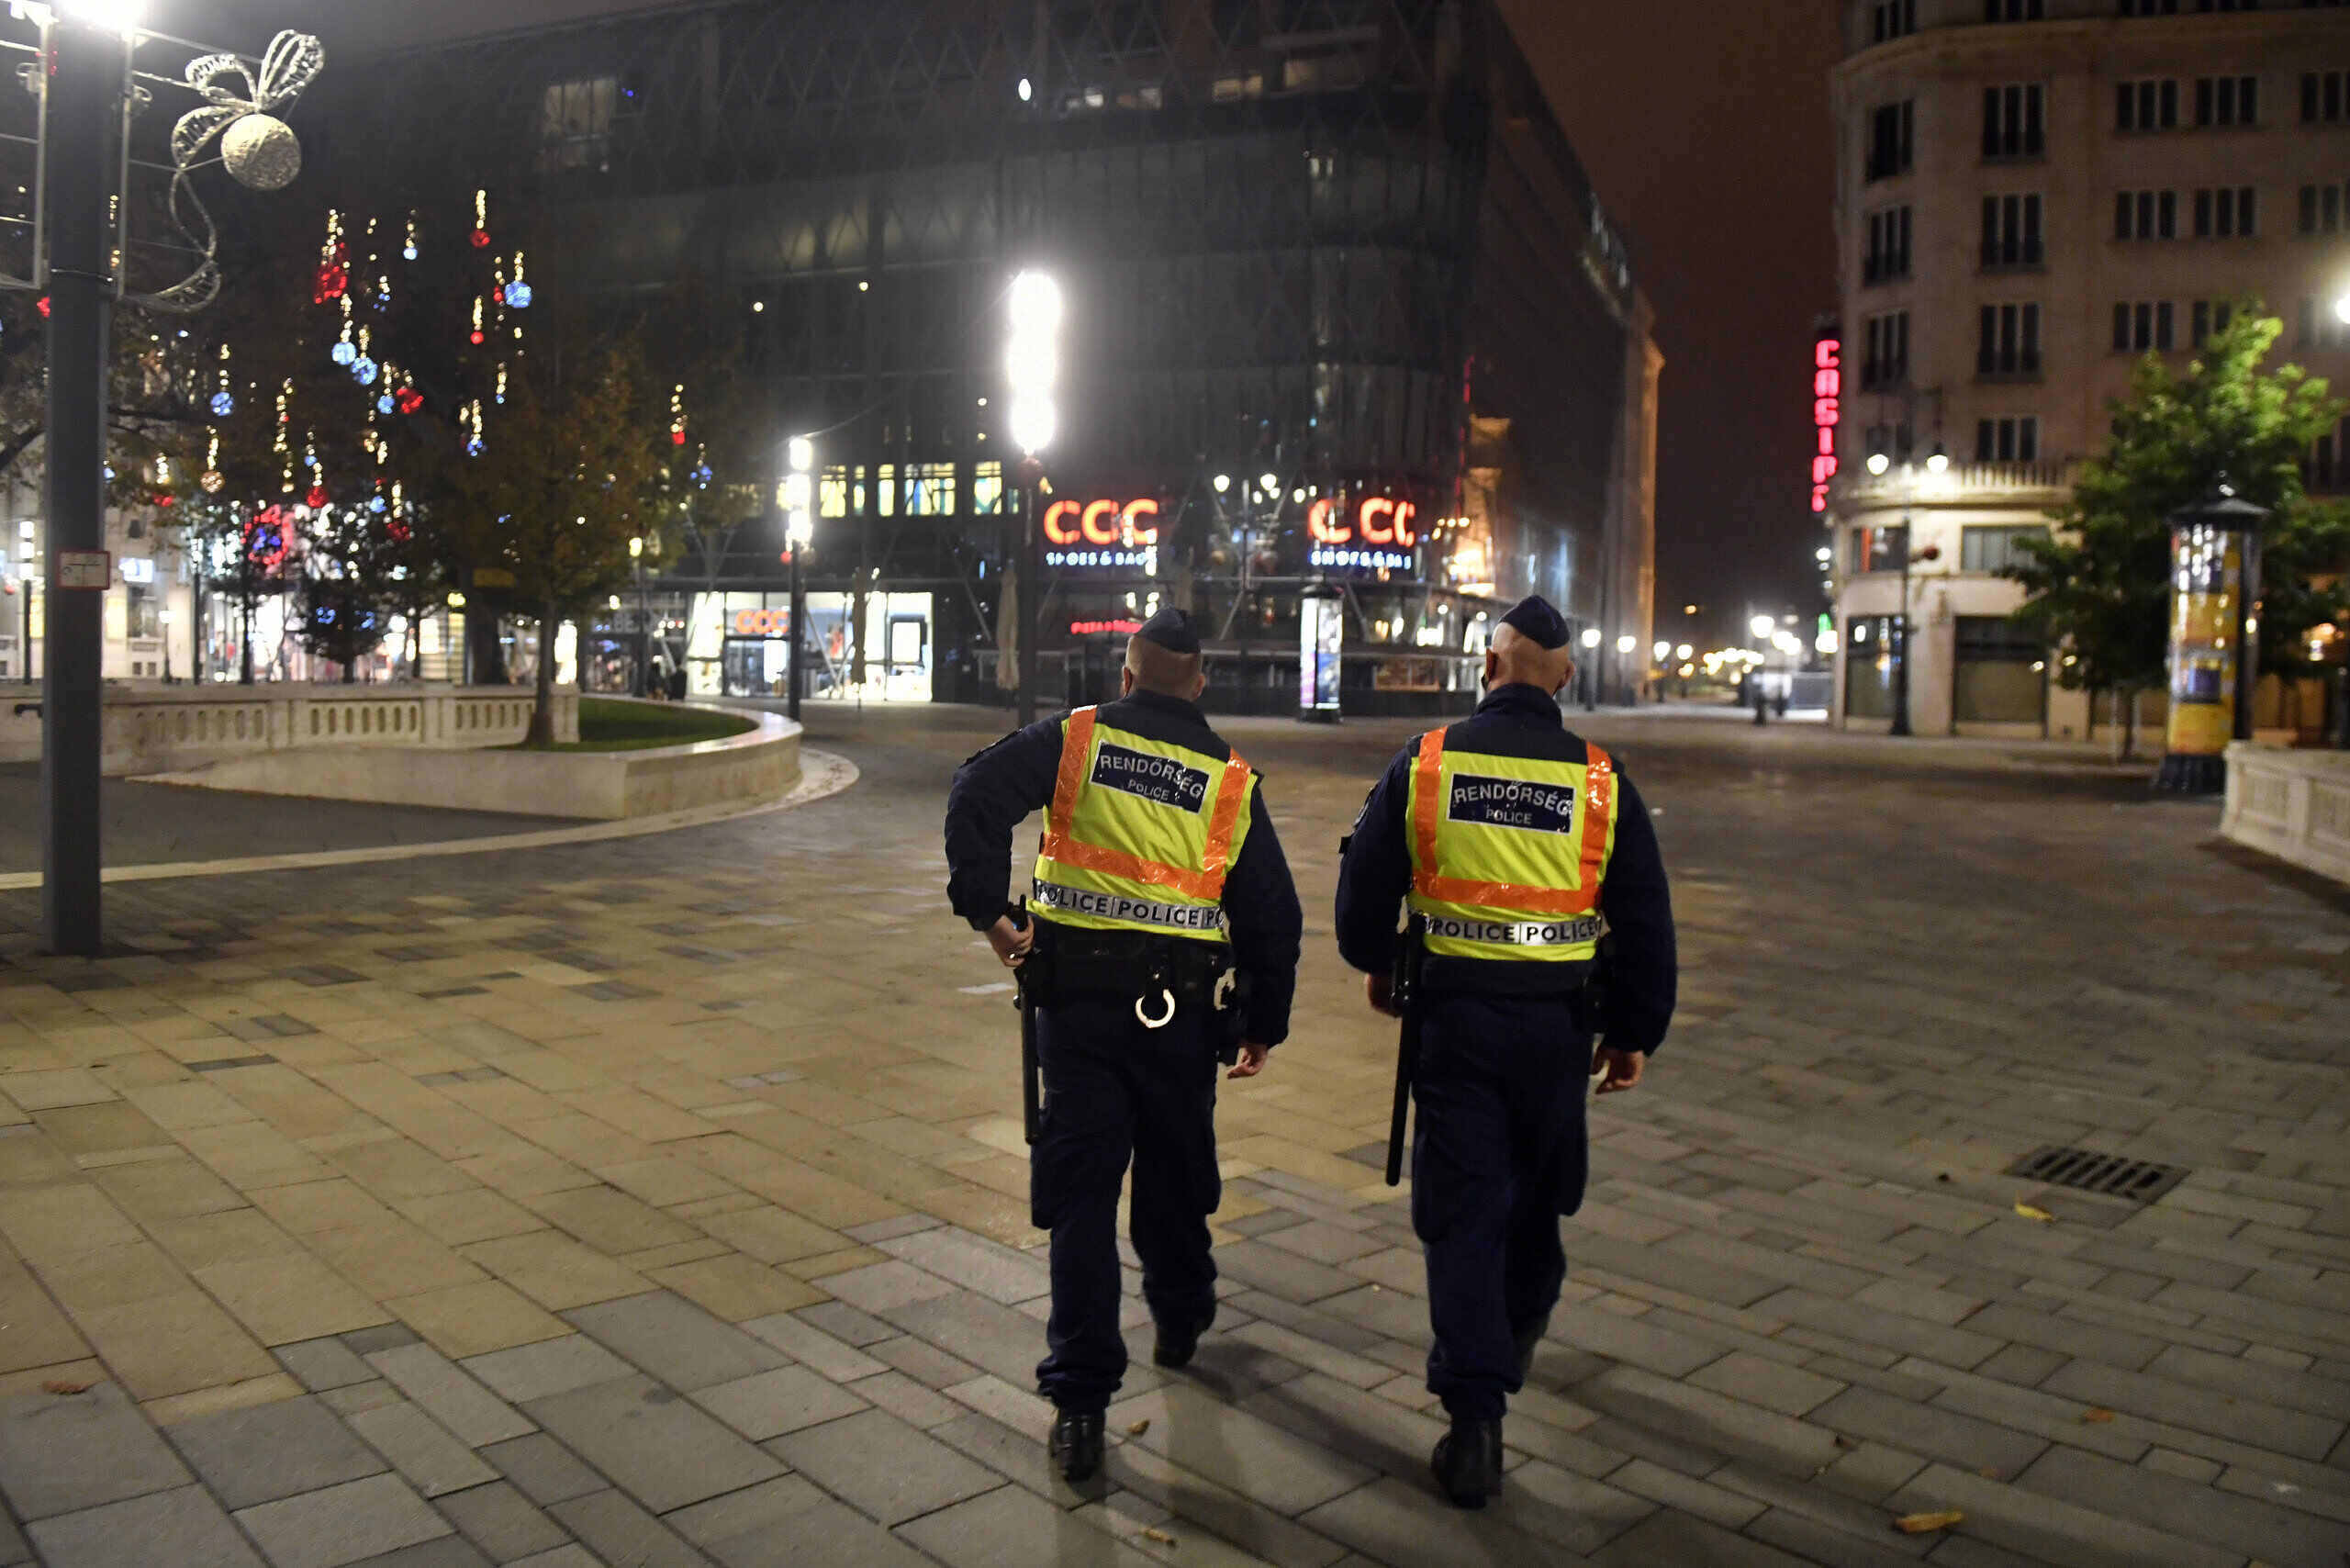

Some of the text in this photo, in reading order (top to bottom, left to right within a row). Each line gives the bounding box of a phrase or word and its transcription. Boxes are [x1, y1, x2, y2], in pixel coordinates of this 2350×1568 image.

[1044, 498, 1158, 545] CCC
[1100, 755, 1203, 799] RENDŐRSÉG
[1127, 778, 1169, 801] POLICE
[1454, 781, 1572, 816] RENDŐRSÉG
[1485, 808, 1532, 824] POLICE
[1117, 901, 1199, 925] POLICE
[1527, 919, 1595, 941] POLICE
